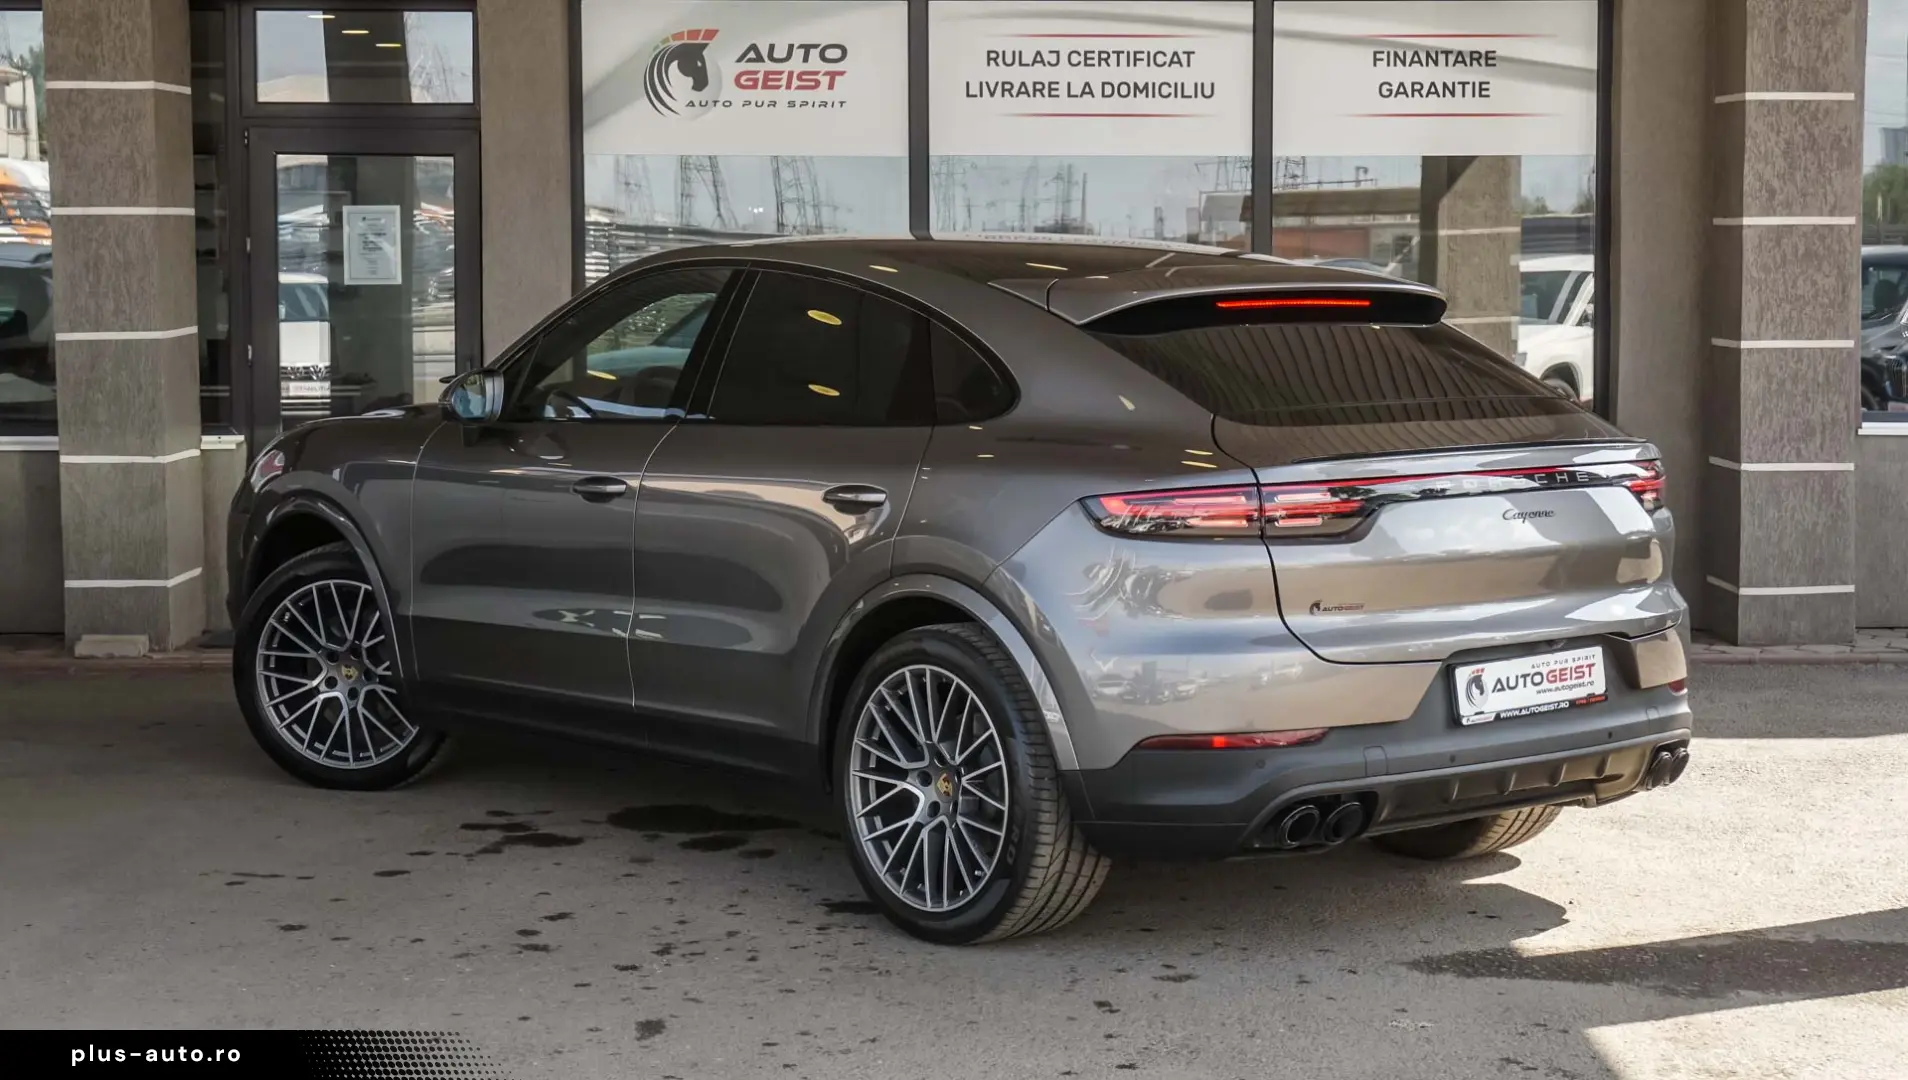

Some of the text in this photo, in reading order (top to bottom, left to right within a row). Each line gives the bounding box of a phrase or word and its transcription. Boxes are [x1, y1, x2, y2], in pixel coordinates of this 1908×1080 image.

[735, 43, 848, 64] AUTO
[986, 50, 1195, 68] RULAJ CERTIFICAT
[1373, 50, 1497, 68] FINANTARE
[734, 70, 847, 91] GEIST
[1378, 81, 1491, 98] GARANTIE
[965, 81, 1215, 99] LIVRARE LA DOMICILIU
[685, 100, 847, 108] AUTO PUR SPIRIT
[1502, 508, 1556, 523] Cayenne
[1531, 660, 1551, 669] AUTO
[1536, 680, 1595, 695] www.autogeist.ro
[1500, 701, 1570, 719] WWW.AUTOGEIST.RO
